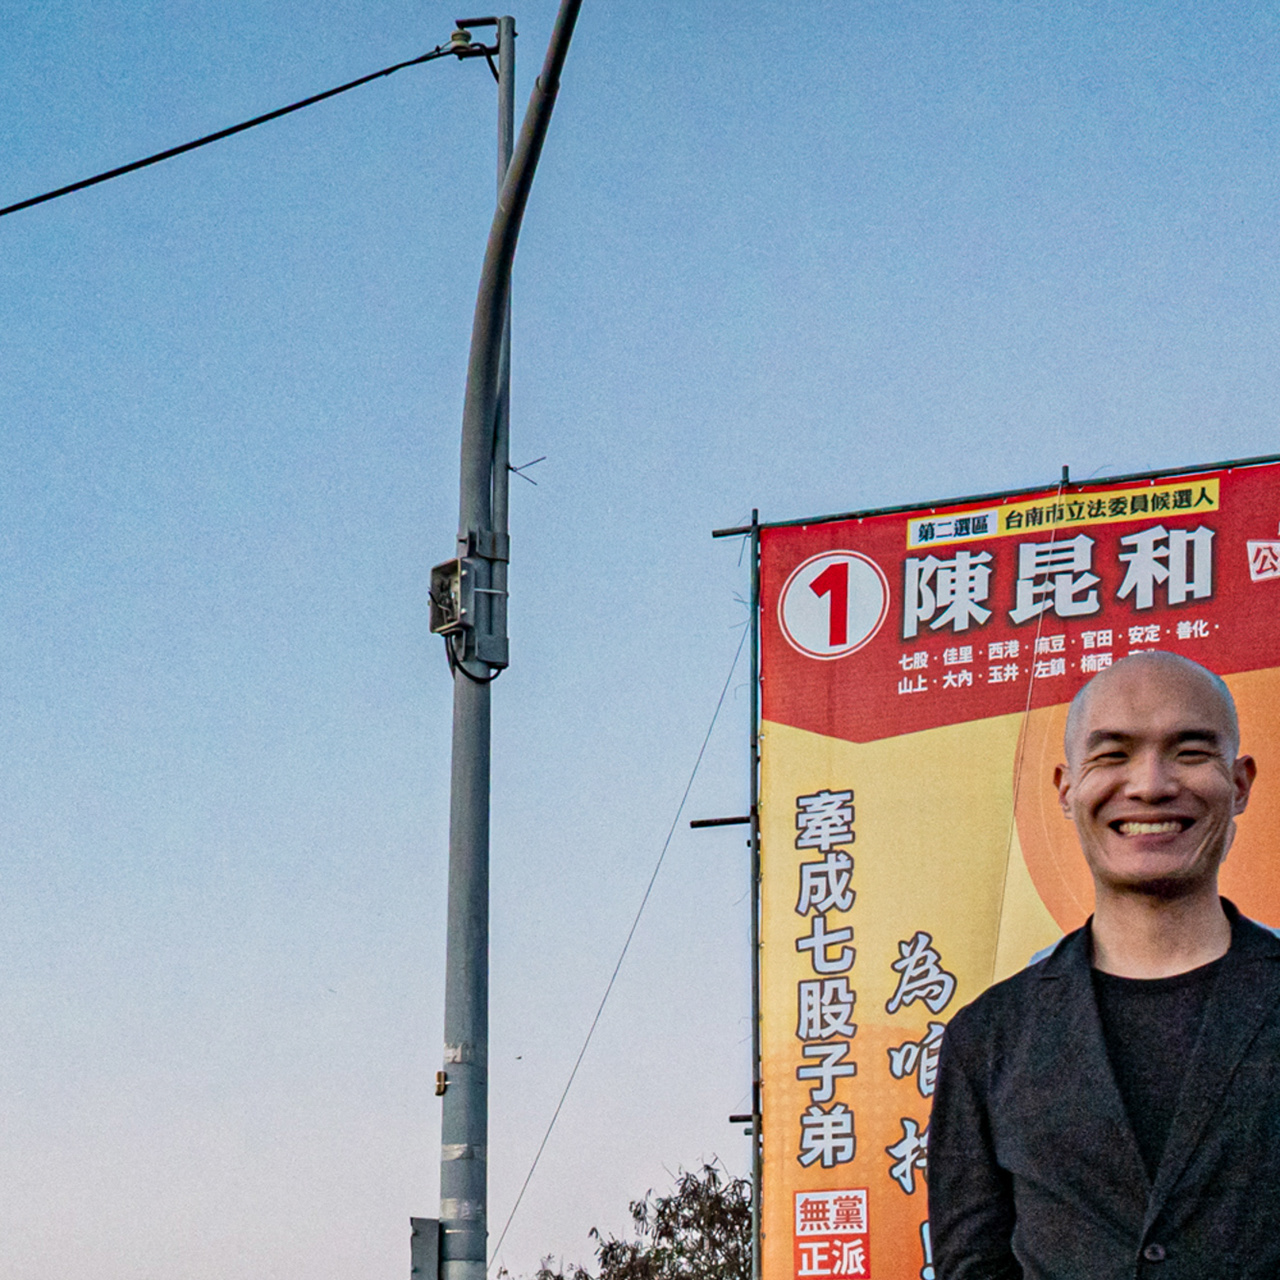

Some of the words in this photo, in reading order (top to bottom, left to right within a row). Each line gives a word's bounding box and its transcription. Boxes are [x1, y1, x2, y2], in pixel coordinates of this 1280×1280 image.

[918, 514, 989, 542] 第二選區
[1005, 486, 1214, 530] 台南市立法委員候選人
[808, 562, 849, 645] 1
[903, 525, 1215, 639] 陳昆和
[796, 788, 857, 1168] 牽成七股子弟
[799, 1195, 864, 1232] 無黨
[798, 1238, 867, 1277] 正派
